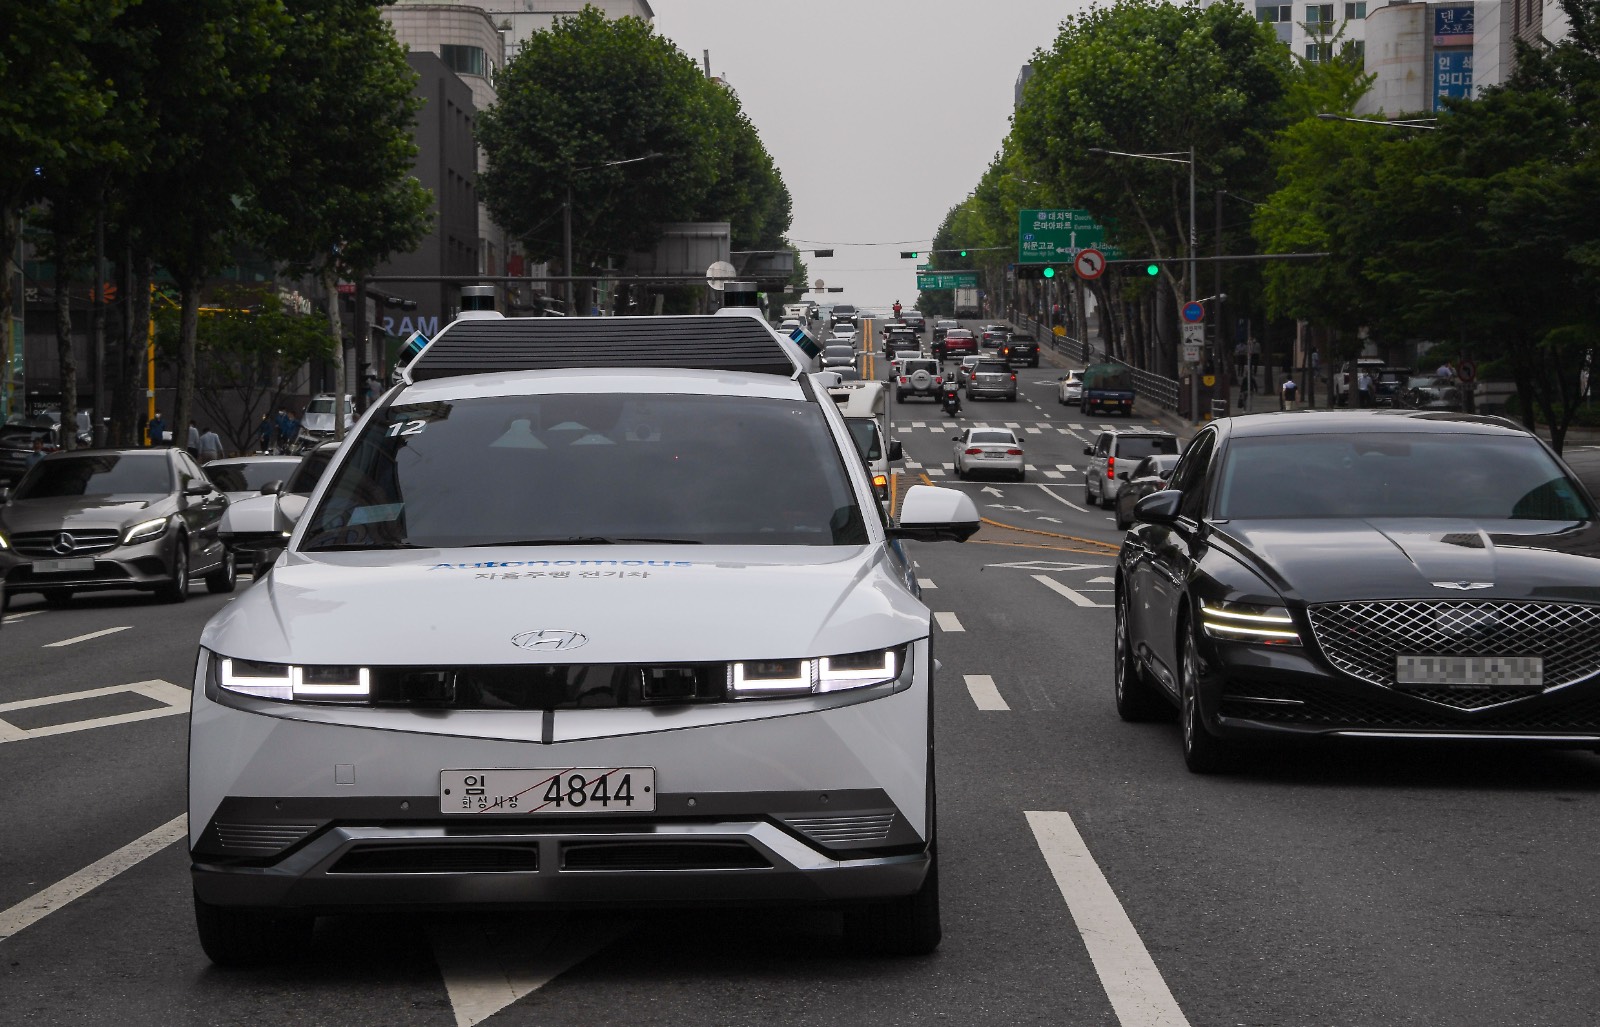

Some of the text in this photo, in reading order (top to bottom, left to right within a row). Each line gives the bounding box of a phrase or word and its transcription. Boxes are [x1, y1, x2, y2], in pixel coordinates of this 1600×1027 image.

[1048, 212, 1072, 220] 대치역
[1033, 221, 1072, 230] 은마아파트
[389, 420, 426, 436] 12
[427, 560, 693, 571] Autonomous
[475, 571, 651, 580] 자율주행 전기차
[464, 775, 485, 795] 임
[543, 774, 634, 807] 4844
